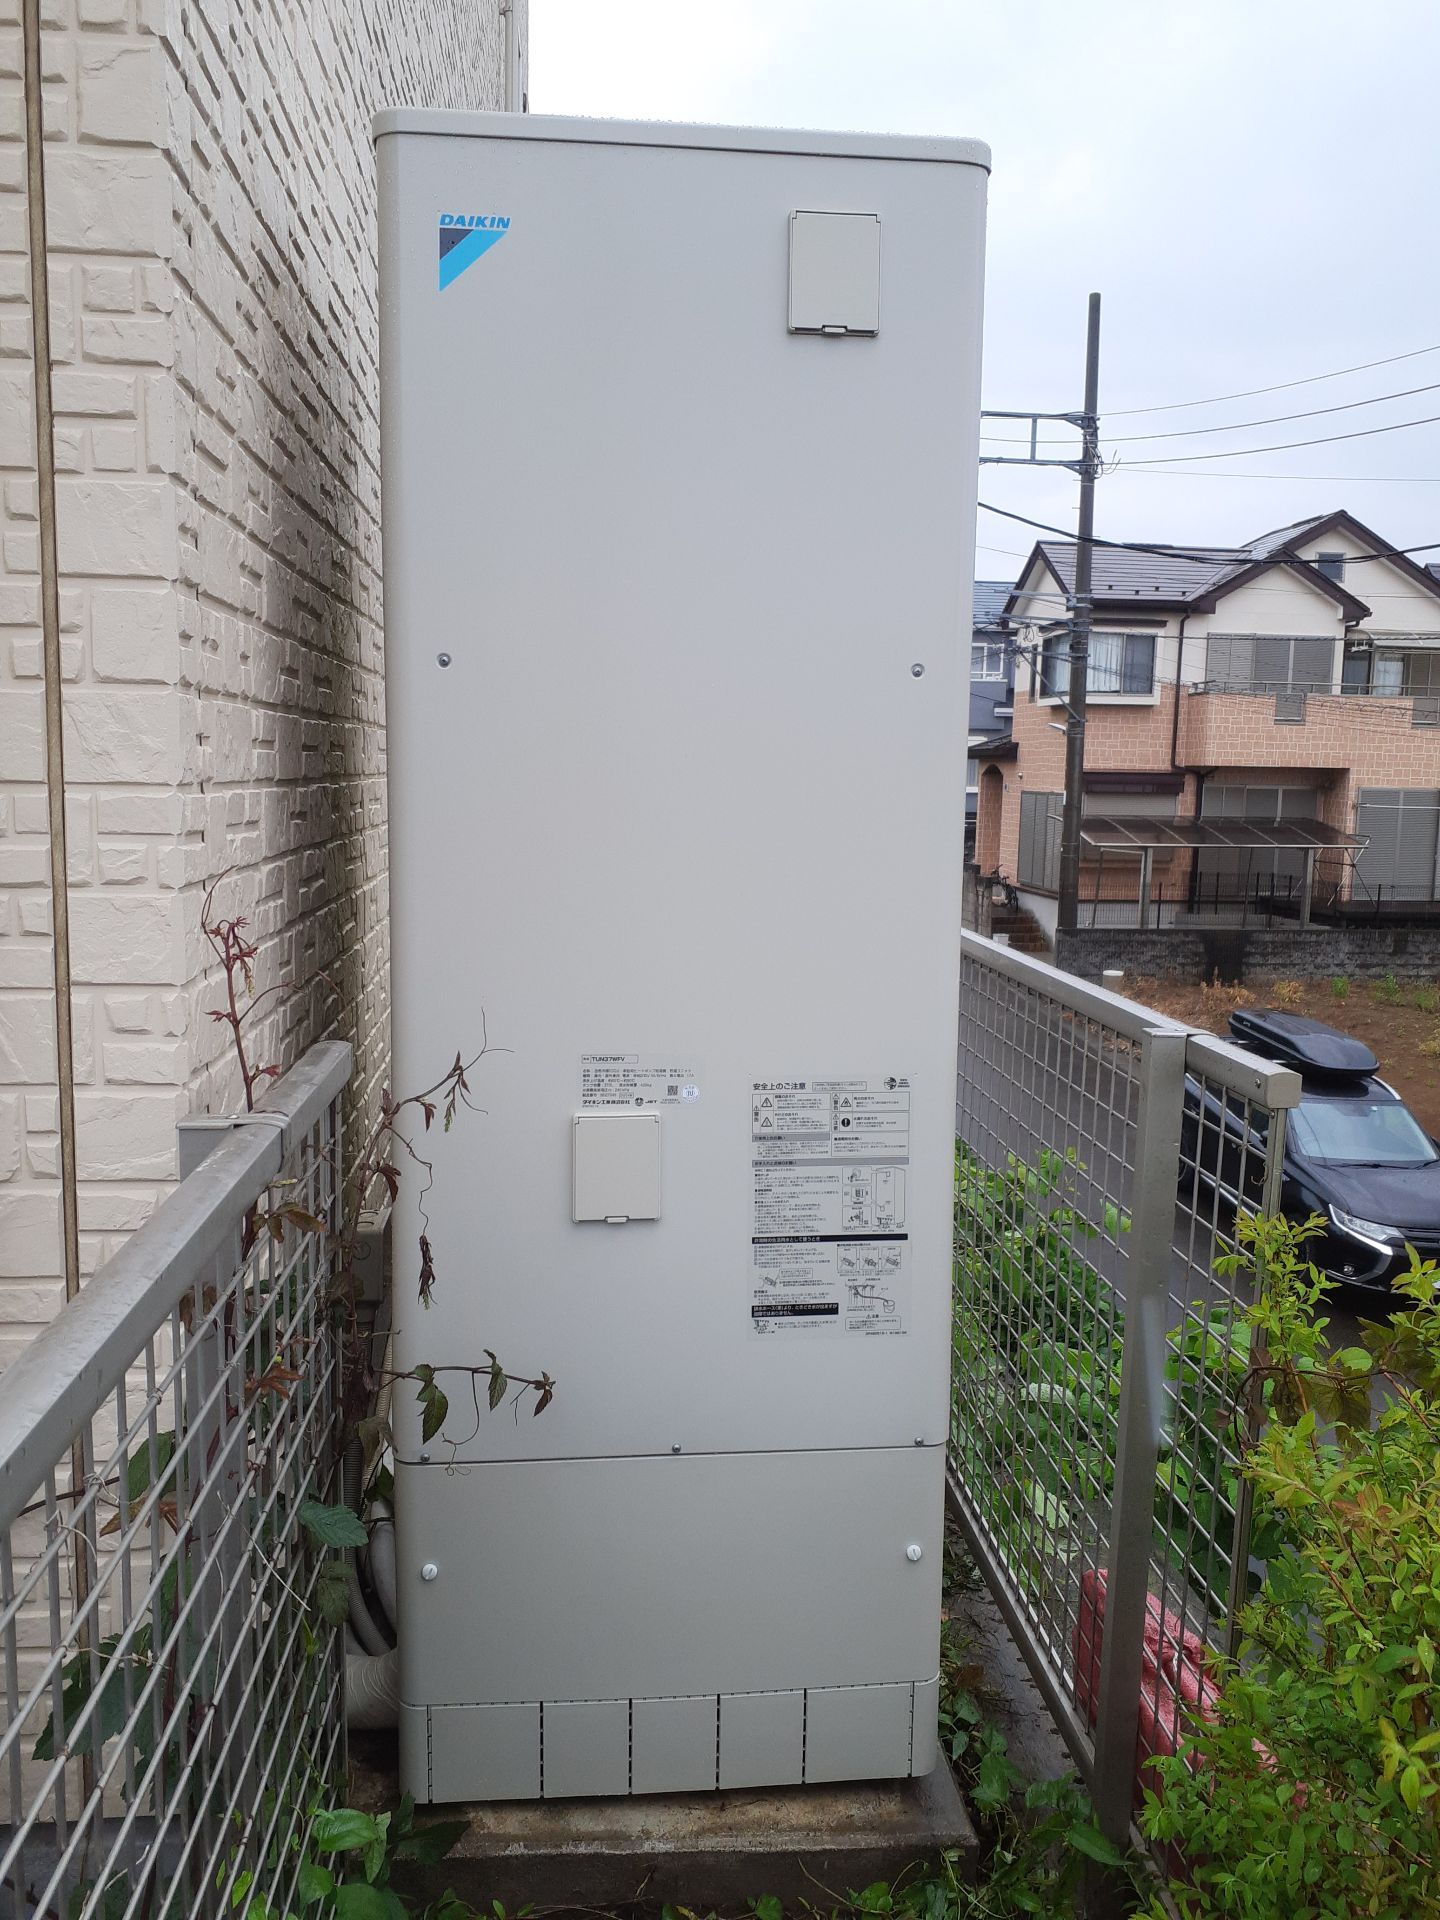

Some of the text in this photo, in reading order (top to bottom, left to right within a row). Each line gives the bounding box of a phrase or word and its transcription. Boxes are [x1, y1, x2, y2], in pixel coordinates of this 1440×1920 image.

[440, 214, 510, 228] DAIKIN
[753, 1082, 806, 1091] 安全上のご注意
